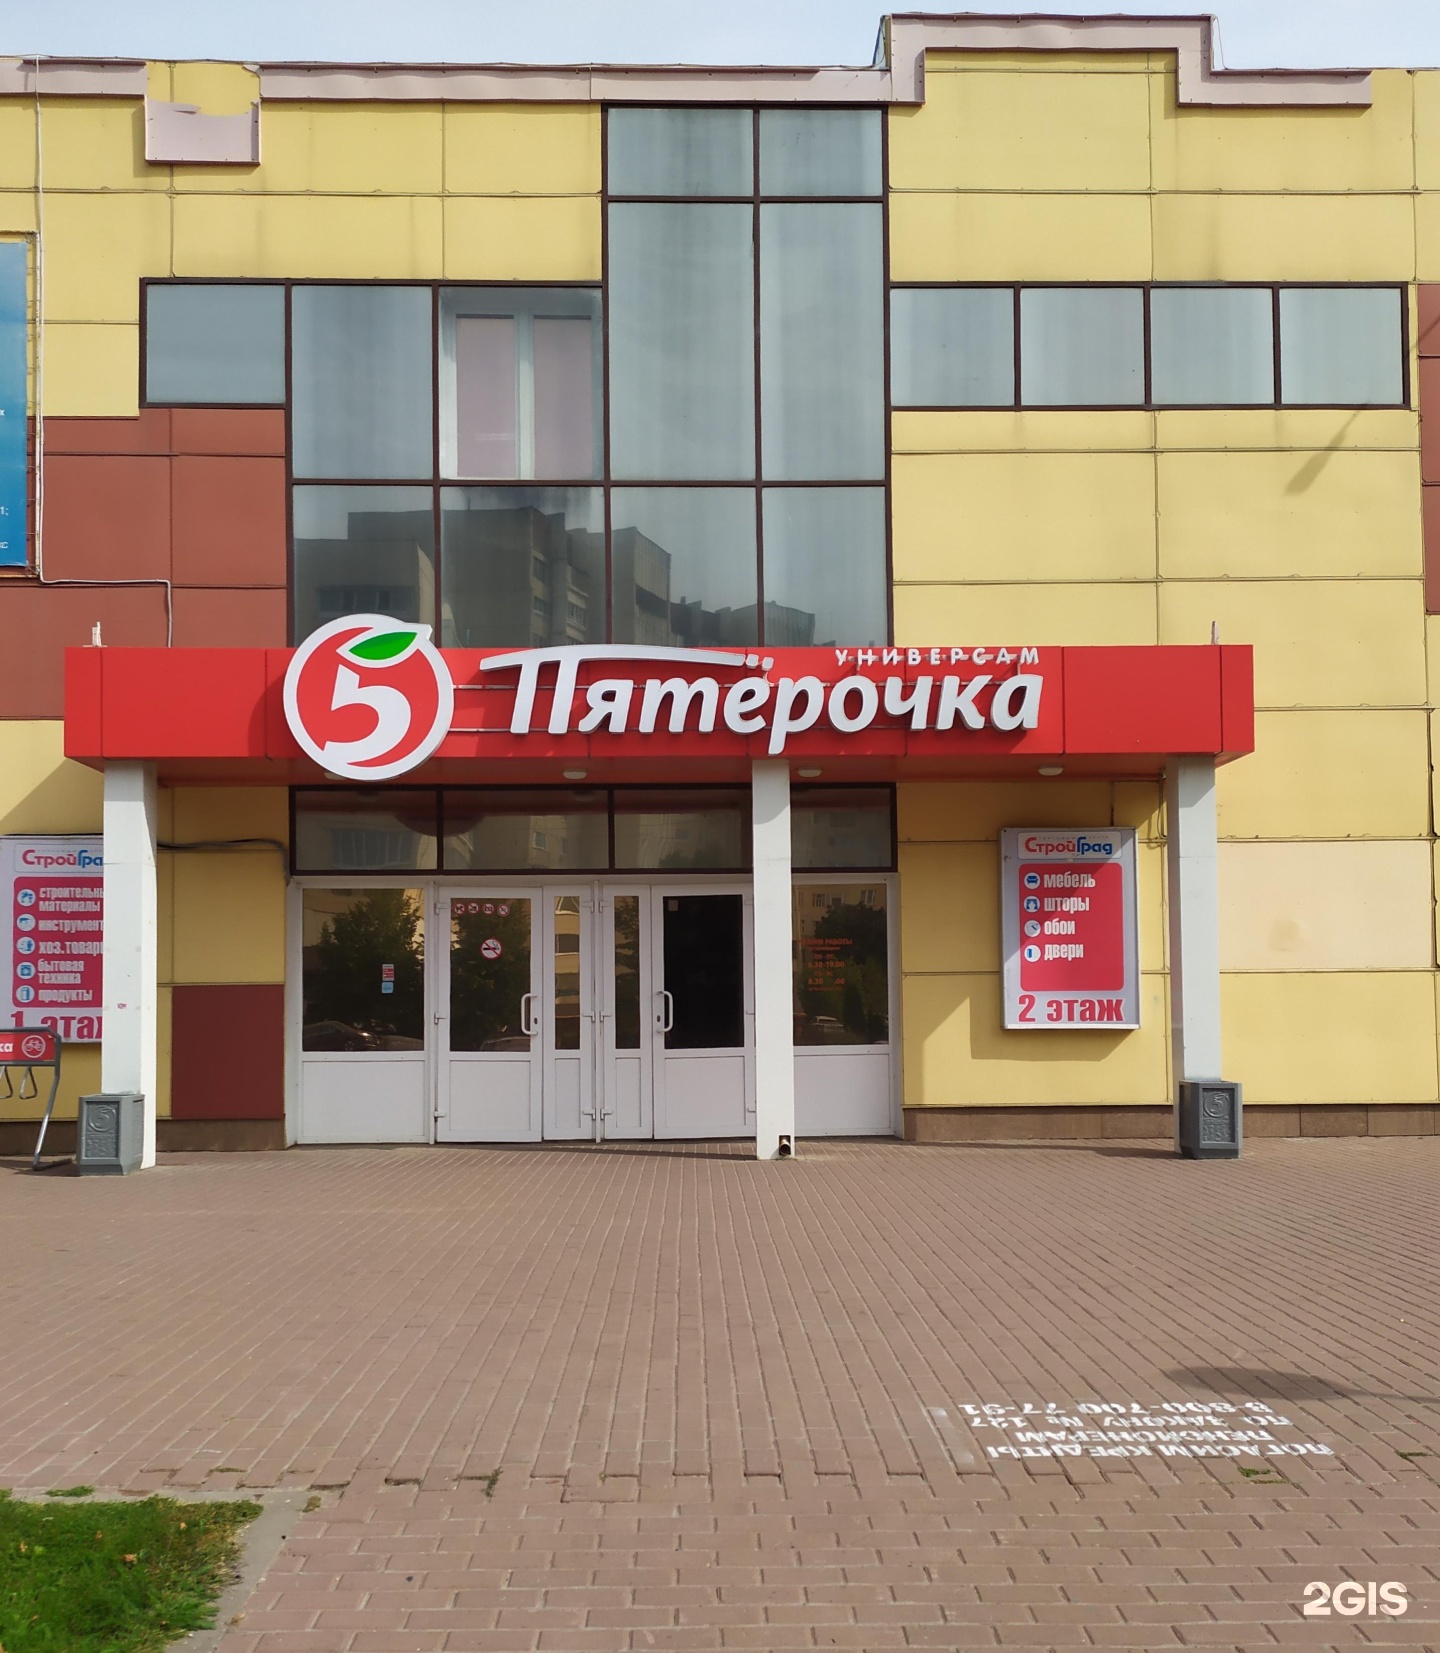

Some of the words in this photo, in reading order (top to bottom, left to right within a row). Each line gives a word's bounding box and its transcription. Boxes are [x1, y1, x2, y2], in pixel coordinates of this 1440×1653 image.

[835, 647, 1040, 666] УНИВЕРСАМ
[480, 644, 1043, 756] Пятёрочка
[1025, 837, 1113, 856] СтройГрад
[1044, 871, 1095, 888] мебель
[39, 901, 100, 914] материалы
[1044, 897, 1090, 914] шторы
[1044, 918, 1075, 935] обои
[1044, 943, 1084, 961] двери
[38, 959, 84, 972] бытовая
[38, 973, 81, 984] техника
[39, 989, 93, 1003] продукты
[1018, 994, 1036, 1022] 2
[1046, 998, 1124, 1022] этаж
[1103, 1415, 1228, 1428] ЗАКОНУ
[1238, 1415, 1293, 1426] ПО
[1015, 1430, 1275, 1444] ПЕНСИОНЕРАМ
[986, 1444, 1153, 1459] КРЕДИТЫ
[1156, 1443, 1334, 1459] ПОГАСИМ
